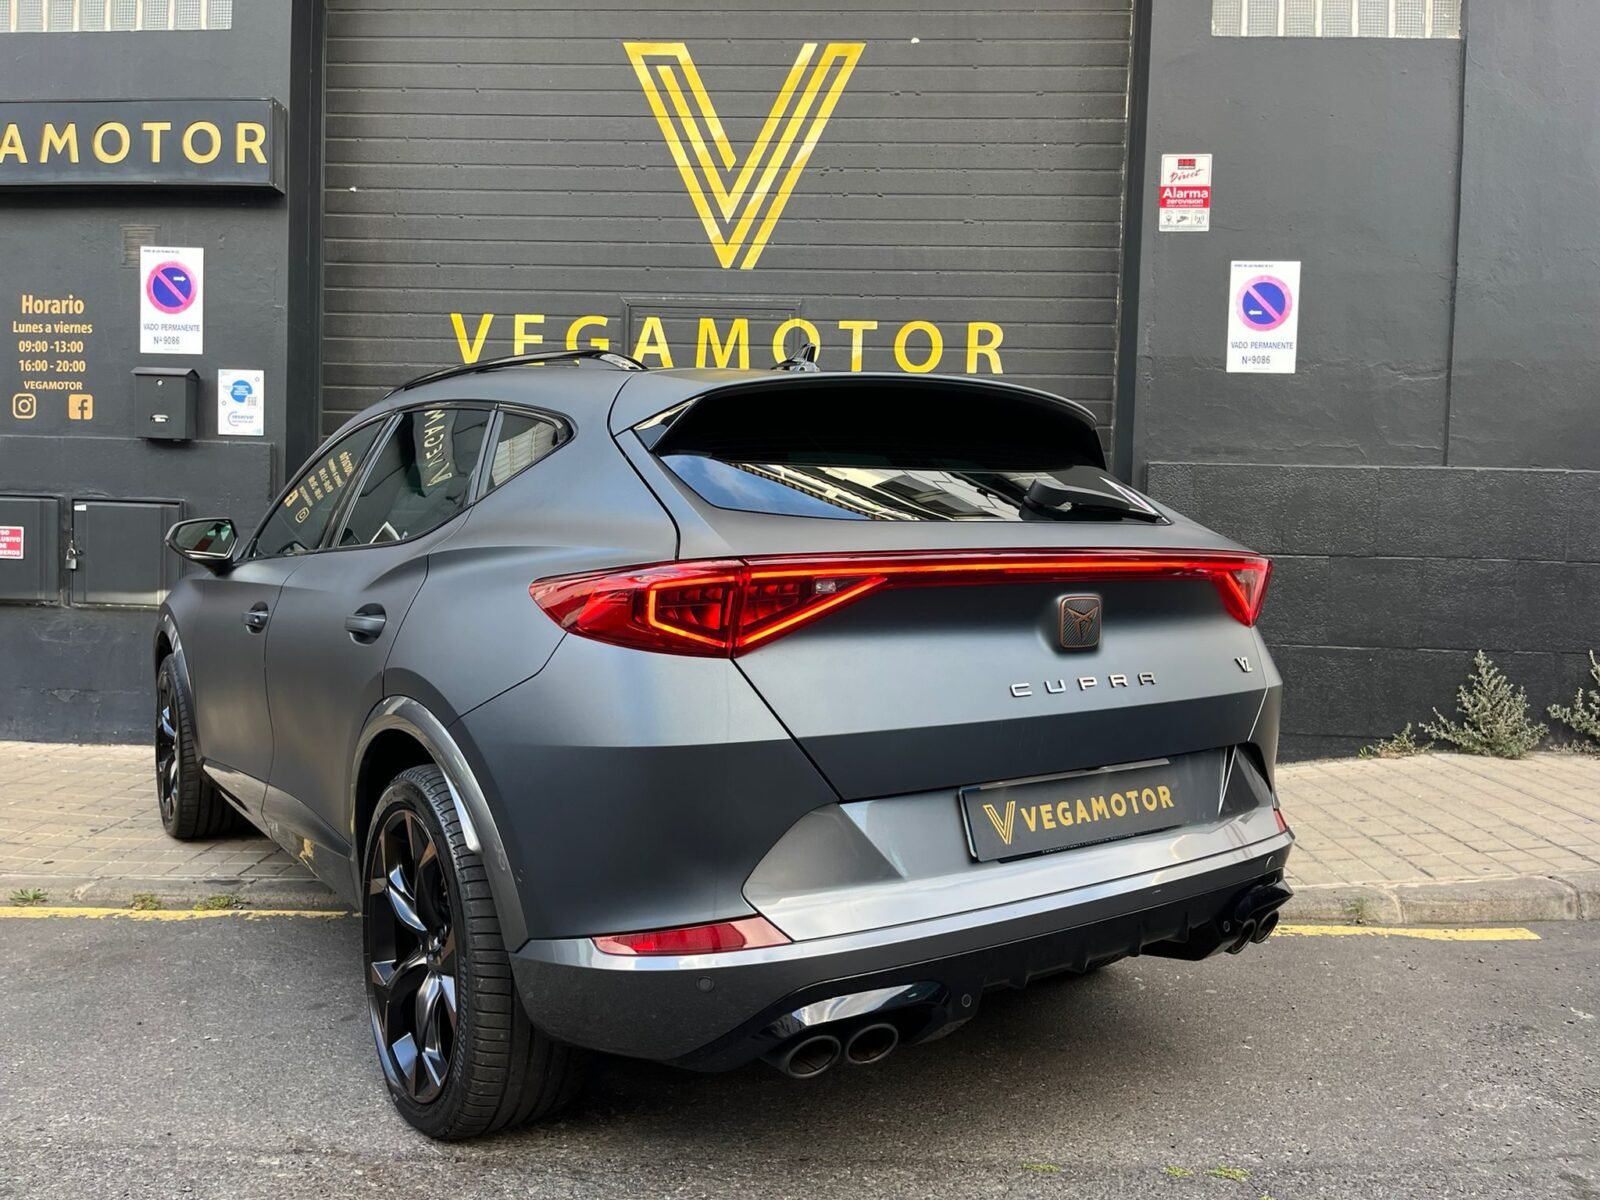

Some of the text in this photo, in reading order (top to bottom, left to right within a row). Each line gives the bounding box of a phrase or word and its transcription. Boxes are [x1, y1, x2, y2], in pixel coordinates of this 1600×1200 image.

[0, 121, 267, 164] AMOTOR
[1162, 187, 1209, 199] Alarma
[21, 294, 85, 315] Horario
[12, 320, 93, 334] Lunes a viernes
[143, 323, 201, 332] VADO PERMANENTE
[18, 340, 48, 353] 09:00
[450, 312, 1005, 375] VEGAMOTOR
[1231, 341, 1294, 350] VADO PERMANENTE
[18, 360, 48, 372] 16:00
[55, 360, 86, 373] 20:00
[23, 381, 83, 391] VEGAMOTOR
[1010, 671, 1157, 697] CUPRA
[1020, 784, 1175, 833] VEGAMOTOR
